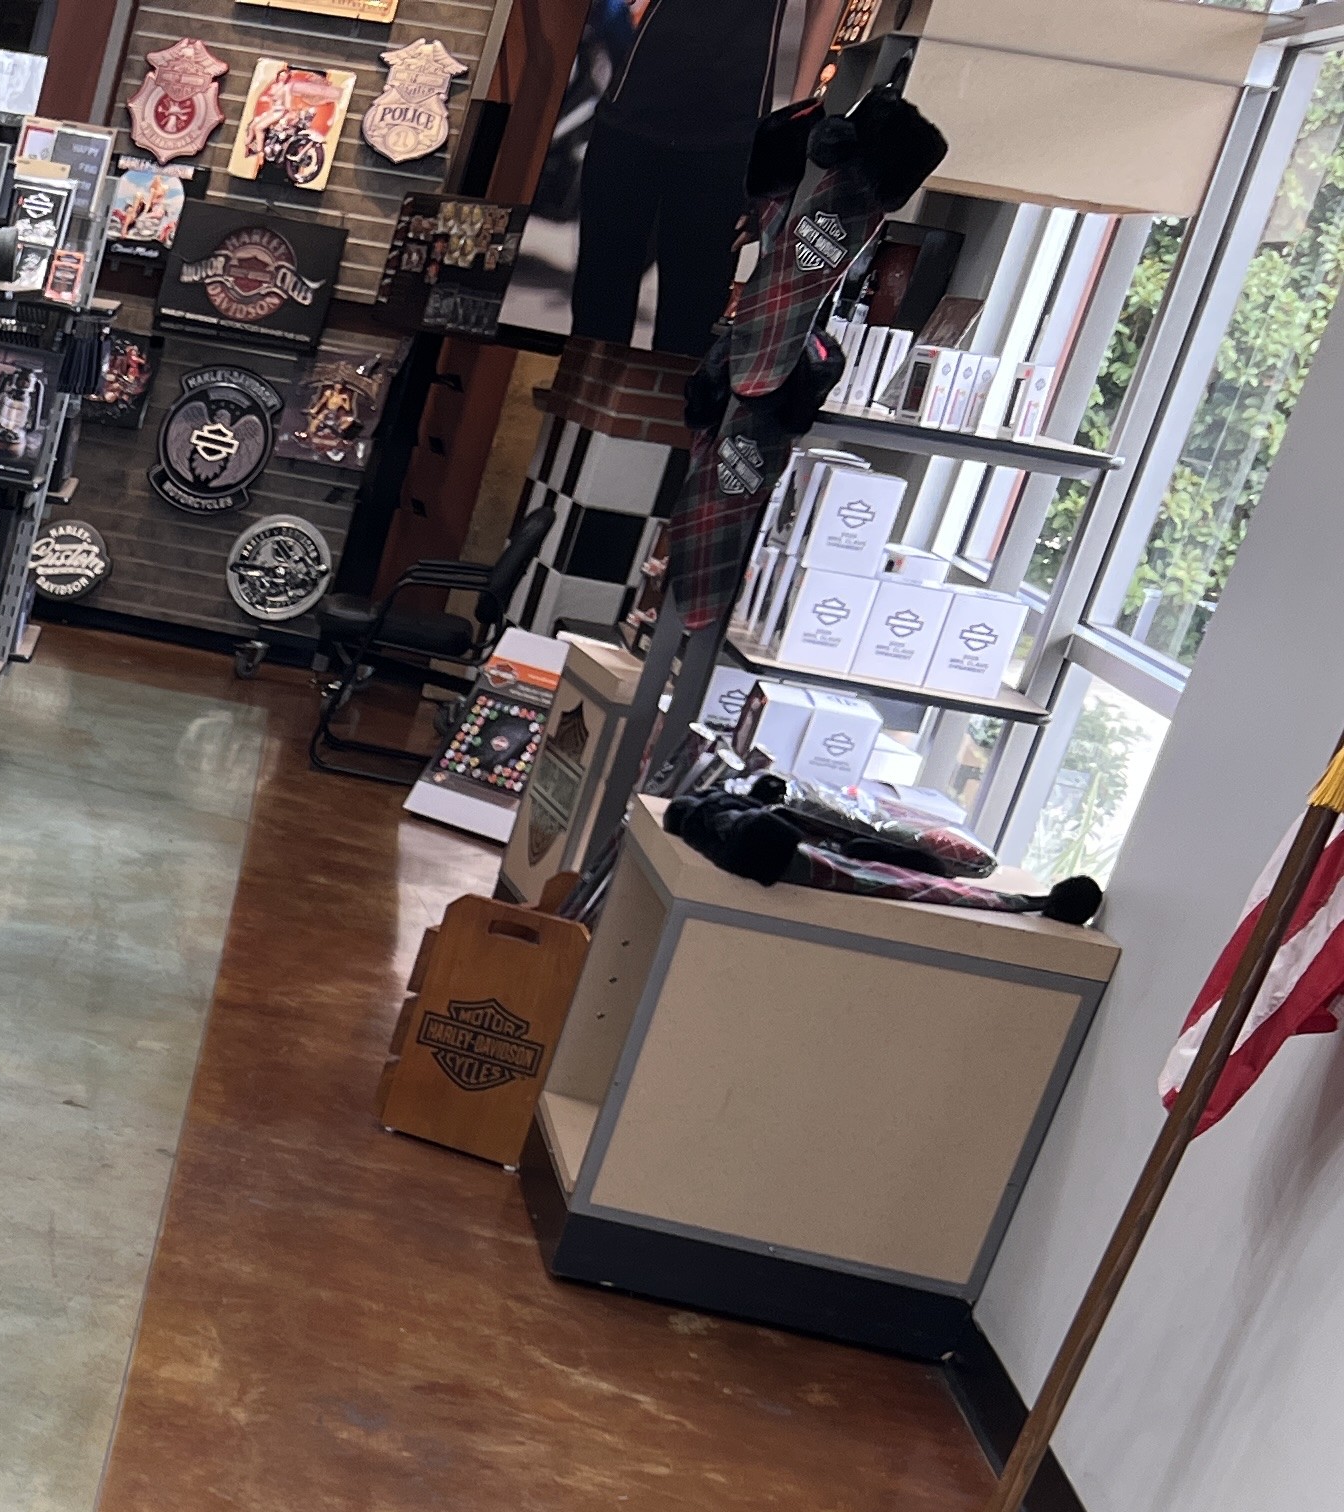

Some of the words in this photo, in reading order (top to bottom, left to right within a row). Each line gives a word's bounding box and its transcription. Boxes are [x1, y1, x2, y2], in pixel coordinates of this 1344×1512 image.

[379, 105, 437, 131] POLICE
[35, 575, 90, 596] DAVIDSON
[456, 1007, 517, 1037] MOTOR
[426, 1020, 535, 1070] HARLEY-DAVIDSON
[445, 1053, 503, 1083] CYCLES
